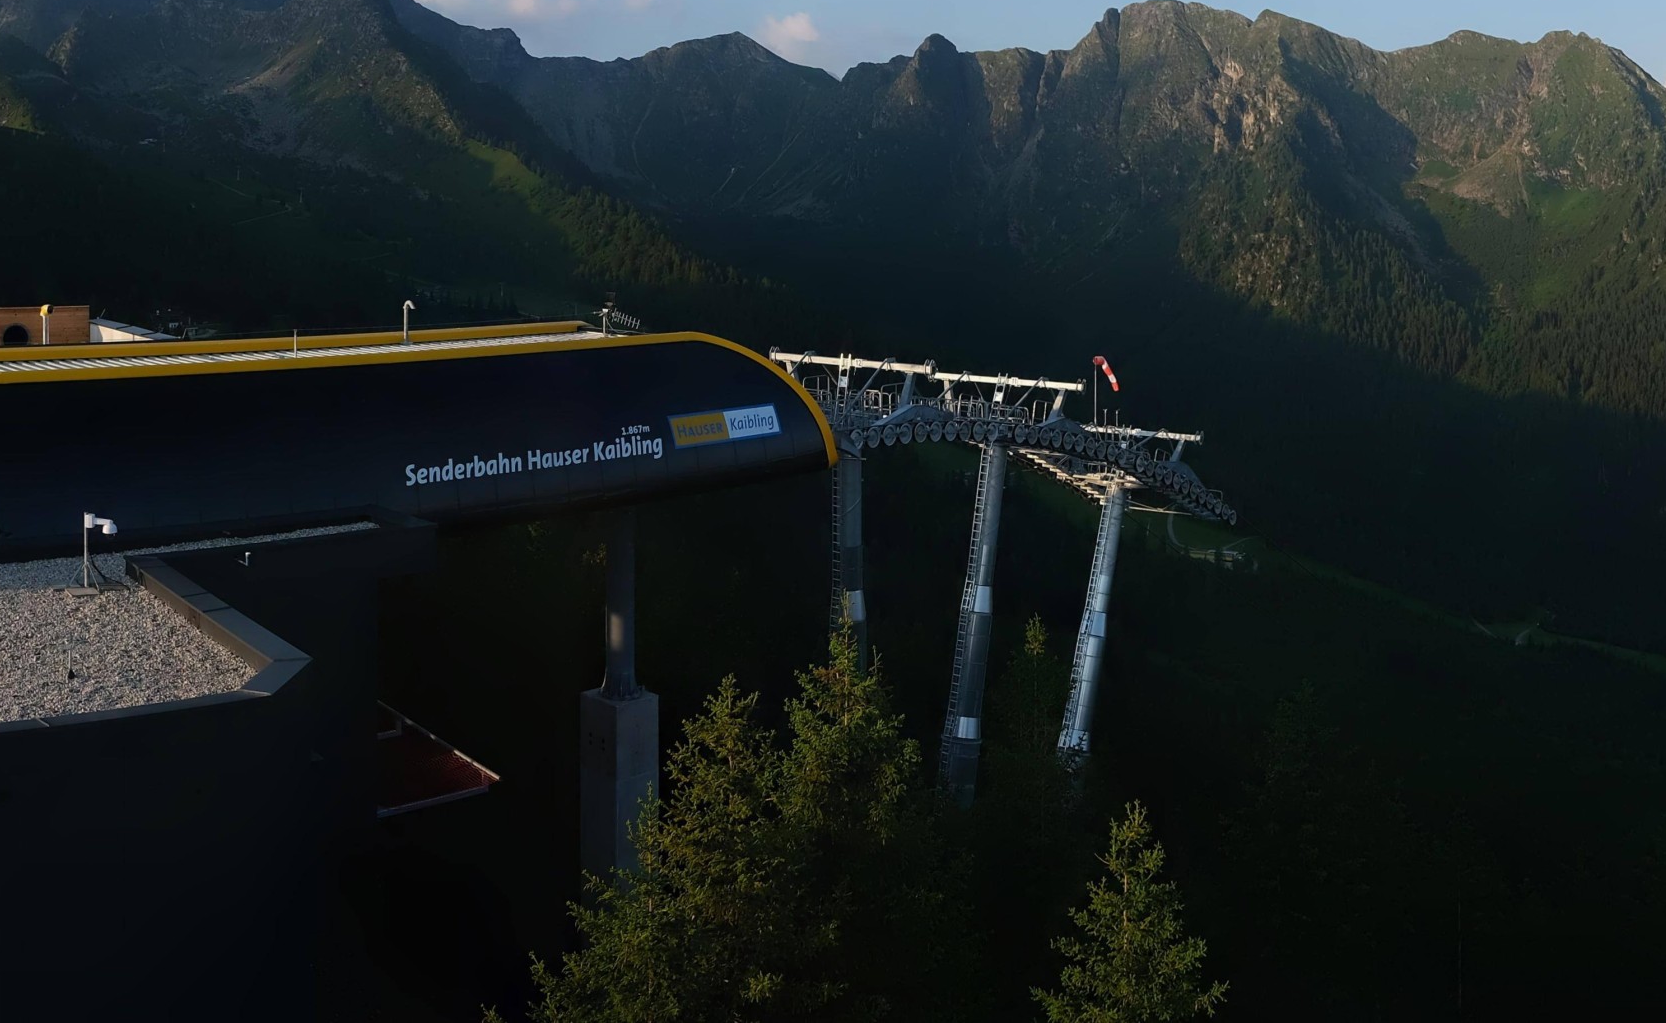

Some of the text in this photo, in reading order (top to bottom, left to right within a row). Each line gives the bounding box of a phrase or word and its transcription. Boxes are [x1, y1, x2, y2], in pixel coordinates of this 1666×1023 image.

[676, 411, 775, 439] HAUSER Kaibling
[405, 434, 663, 486] Senderbahn Hauser Kaibling
